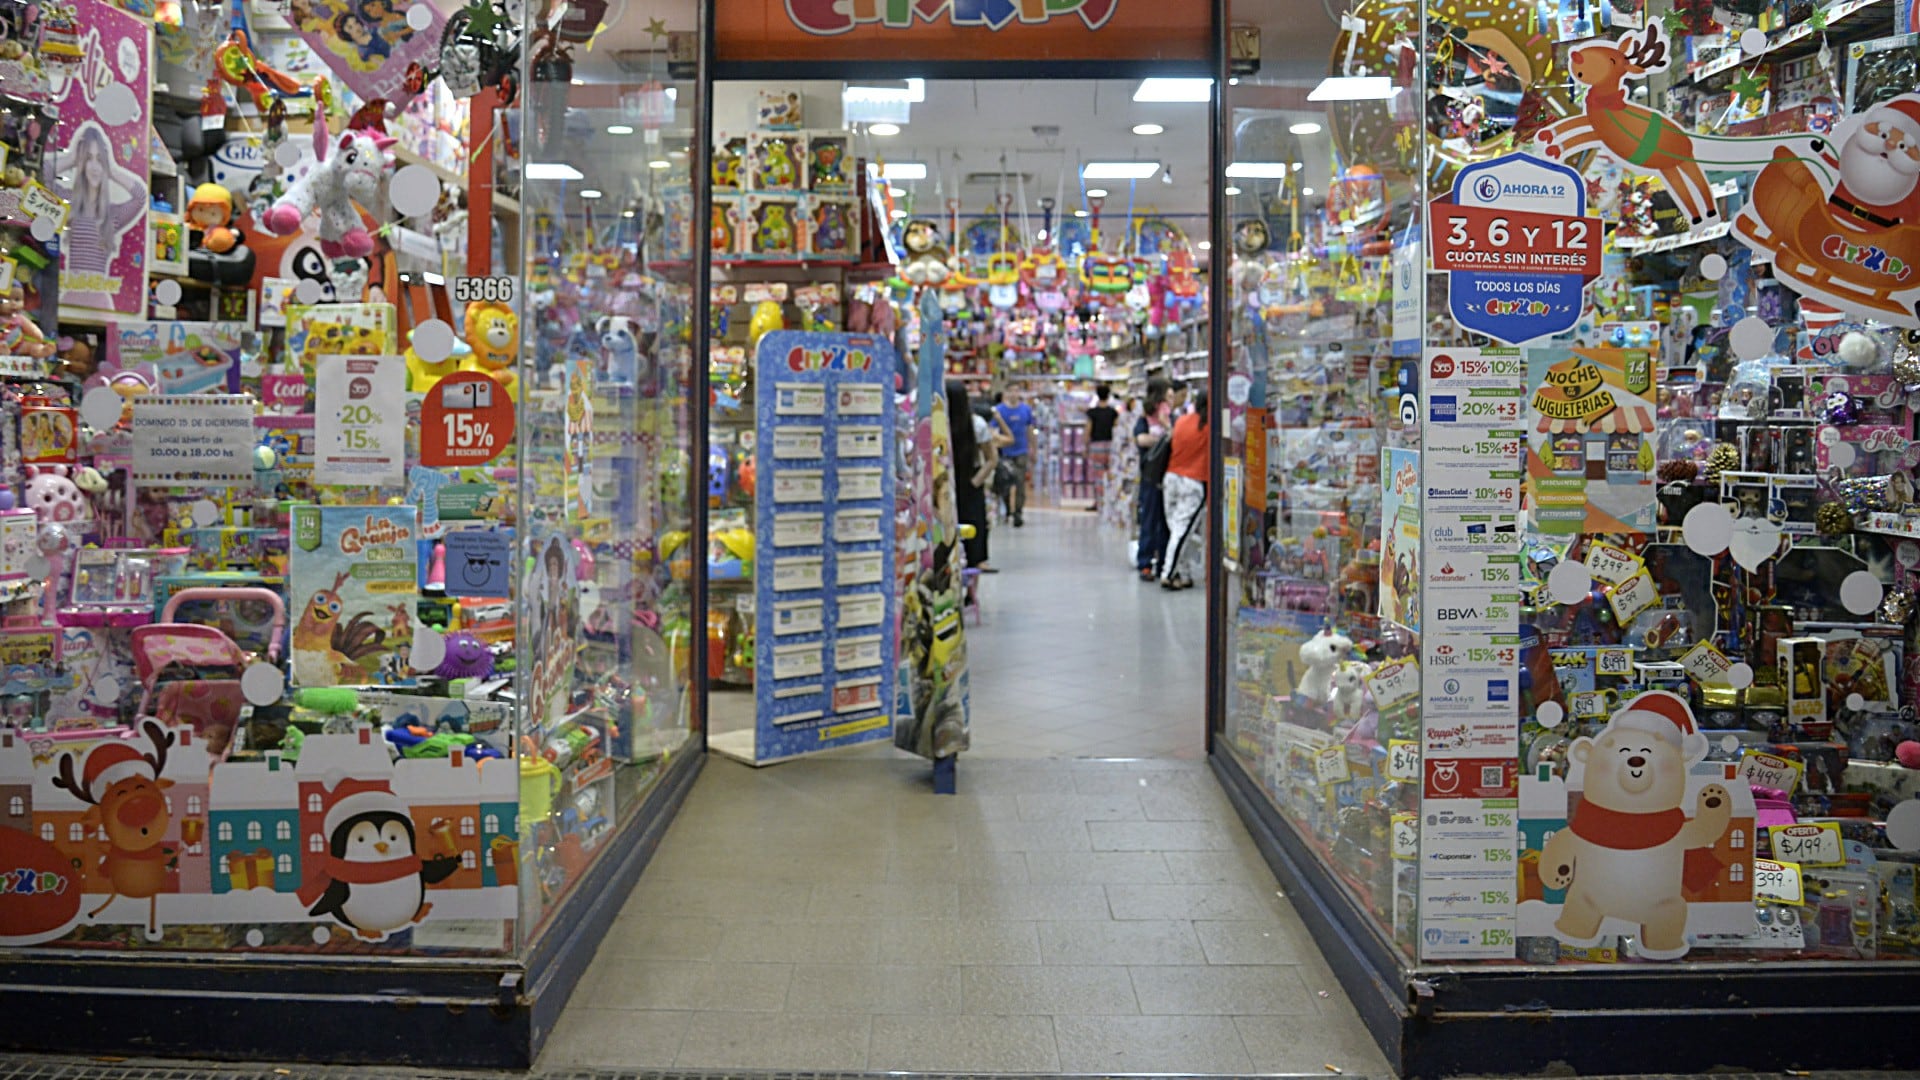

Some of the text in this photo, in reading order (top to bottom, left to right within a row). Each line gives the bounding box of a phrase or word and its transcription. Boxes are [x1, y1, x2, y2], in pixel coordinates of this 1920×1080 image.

[1503, 184, 1565, 196] AHORA 12
[1447, 217, 1588, 249] 3, 6 Y 12
[1446, 251, 1587, 266] CUOTAS SIN INTERÉS
[455, 277, 513, 302] 5366
[1475, 280, 1561, 294] TODOS LOS DÍAS
[1460, 361, 1488, 374] 15%
[1490, 360, 1519, 374] 10%
[1628, 361, 1646, 373] 14
[1544, 365, 1598, 384] NOCHE
[1628, 375, 1645, 384] DIC
[1462, 402, 1496, 416] 20%
[1533, 391, 1610, 416] JUGUETERIAS
[341, 405, 383, 424] 20%
[135, 418, 176, 427] DOMINGO
[191, 418, 202, 427] DE
[205, 419, 250, 427] DICIEMBRE
[443, 413, 494, 447] 15%
[159, 436, 223, 444] Local abierto de
[343, 430, 380, 449] 15%
[150, 448, 180, 457] 10.00
[190, 448, 221, 457] 18.00
[223, 448, 234, 457] hs
[1475, 442, 1502, 454] 15%
[1475, 487, 1498, 499] 10%
[301, 516, 314, 528] 14
[366, 515, 390, 534] La
[1434, 527, 1453, 536] club
[341, 526, 410, 554] Granja
[1467, 533, 1517, 544] 15% 20%
[1481, 568, 1510, 581] 15%
[1437, 606, 1509, 620] BBVA 15%
[1430, 656, 1459, 666] HSBC
[1467, 648, 1496, 661] 15%
[1551, 652, 1587, 665] ZAK
[1601, 656, 1626, 670] $499
[1759, 757, 1785, 769] OFERTA
[1483, 814, 1512, 827] 15%
[1788, 827, 1820, 836] OFERTA
[1438, 849, 1512, 862] Cuponstar 15%
[1755, 862, 1781, 871] FERTA
[1480, 891, 1510, 904] 15%
[1480, 929, 1514, 946] 15%
